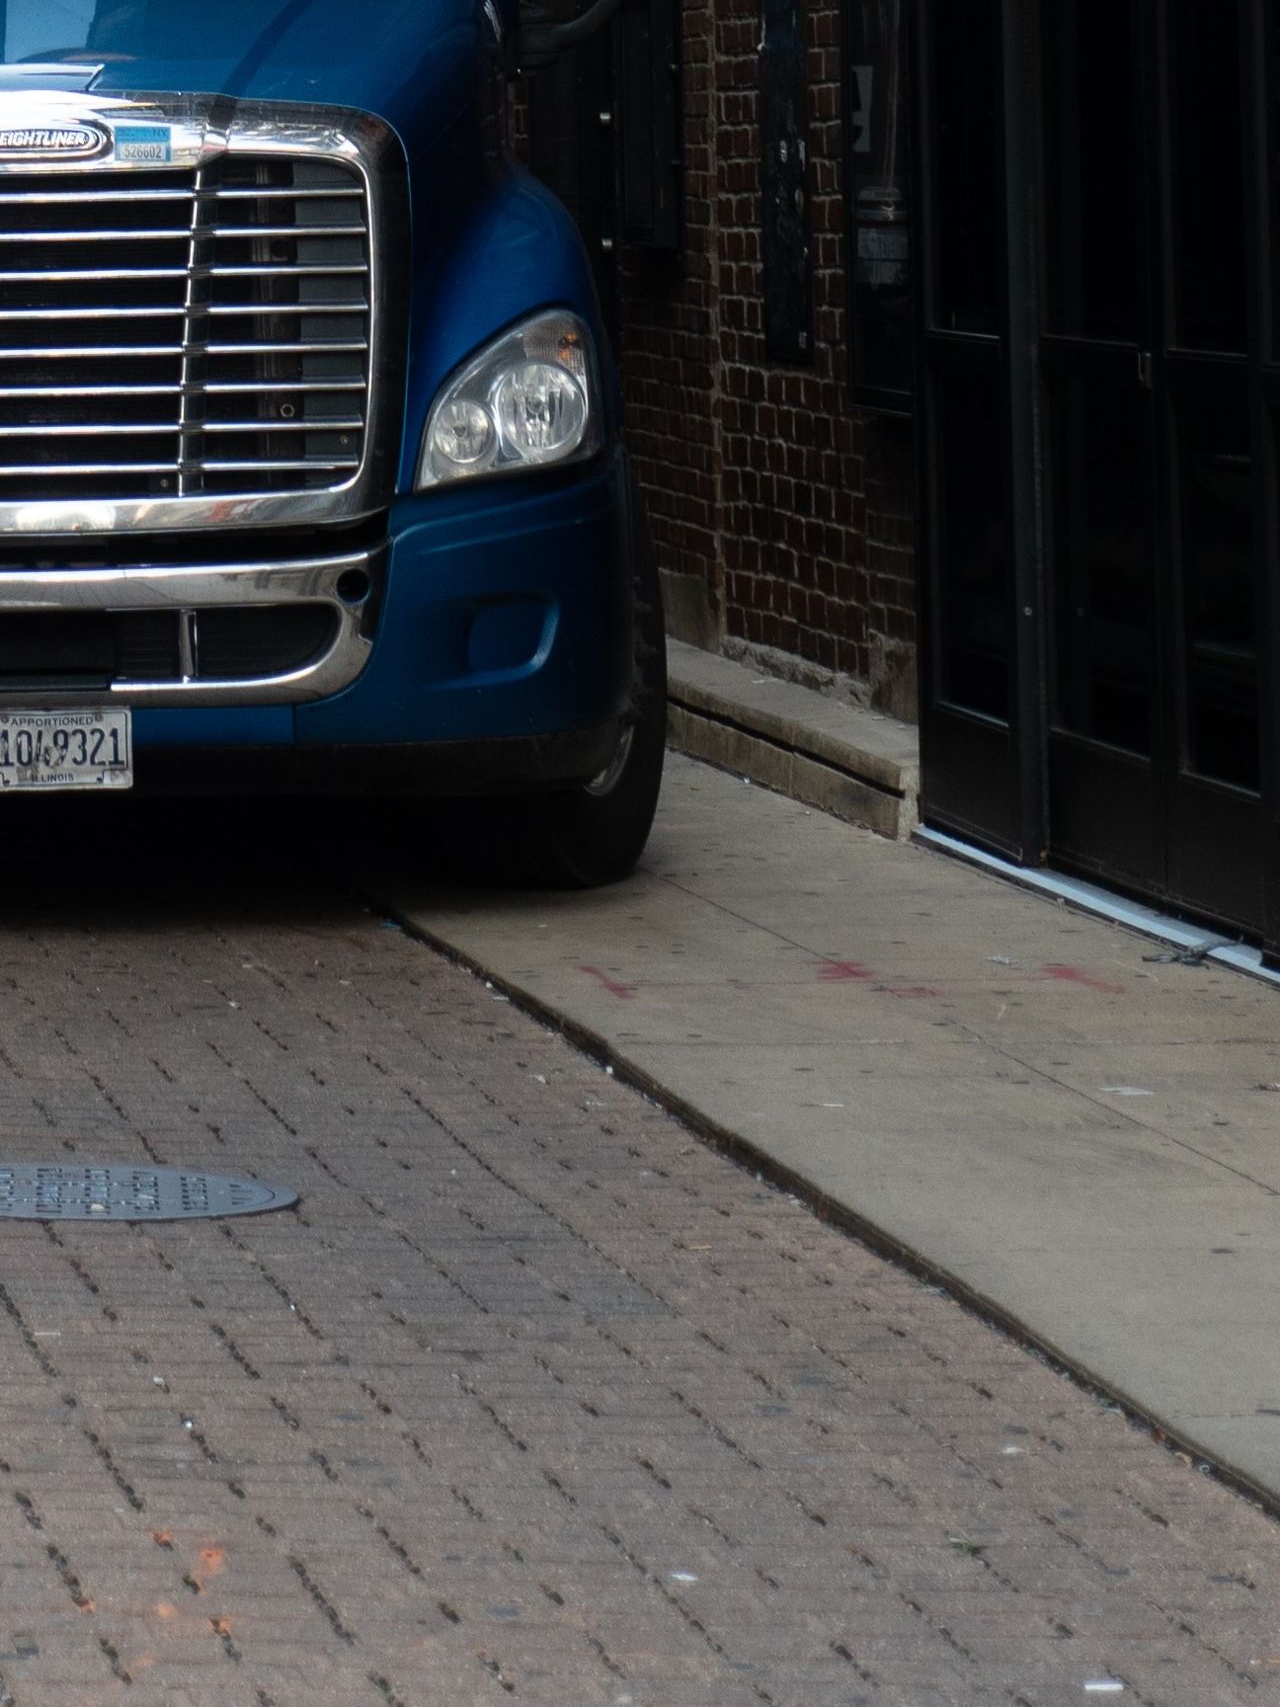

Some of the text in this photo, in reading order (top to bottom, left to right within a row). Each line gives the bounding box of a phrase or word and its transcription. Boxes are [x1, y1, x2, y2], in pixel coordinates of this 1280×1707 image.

[124, 145, 162, 159] 526602
[10, 715, 95, 727] APPORTIONED
[30, 773, 75, 783] ILLINOIS
